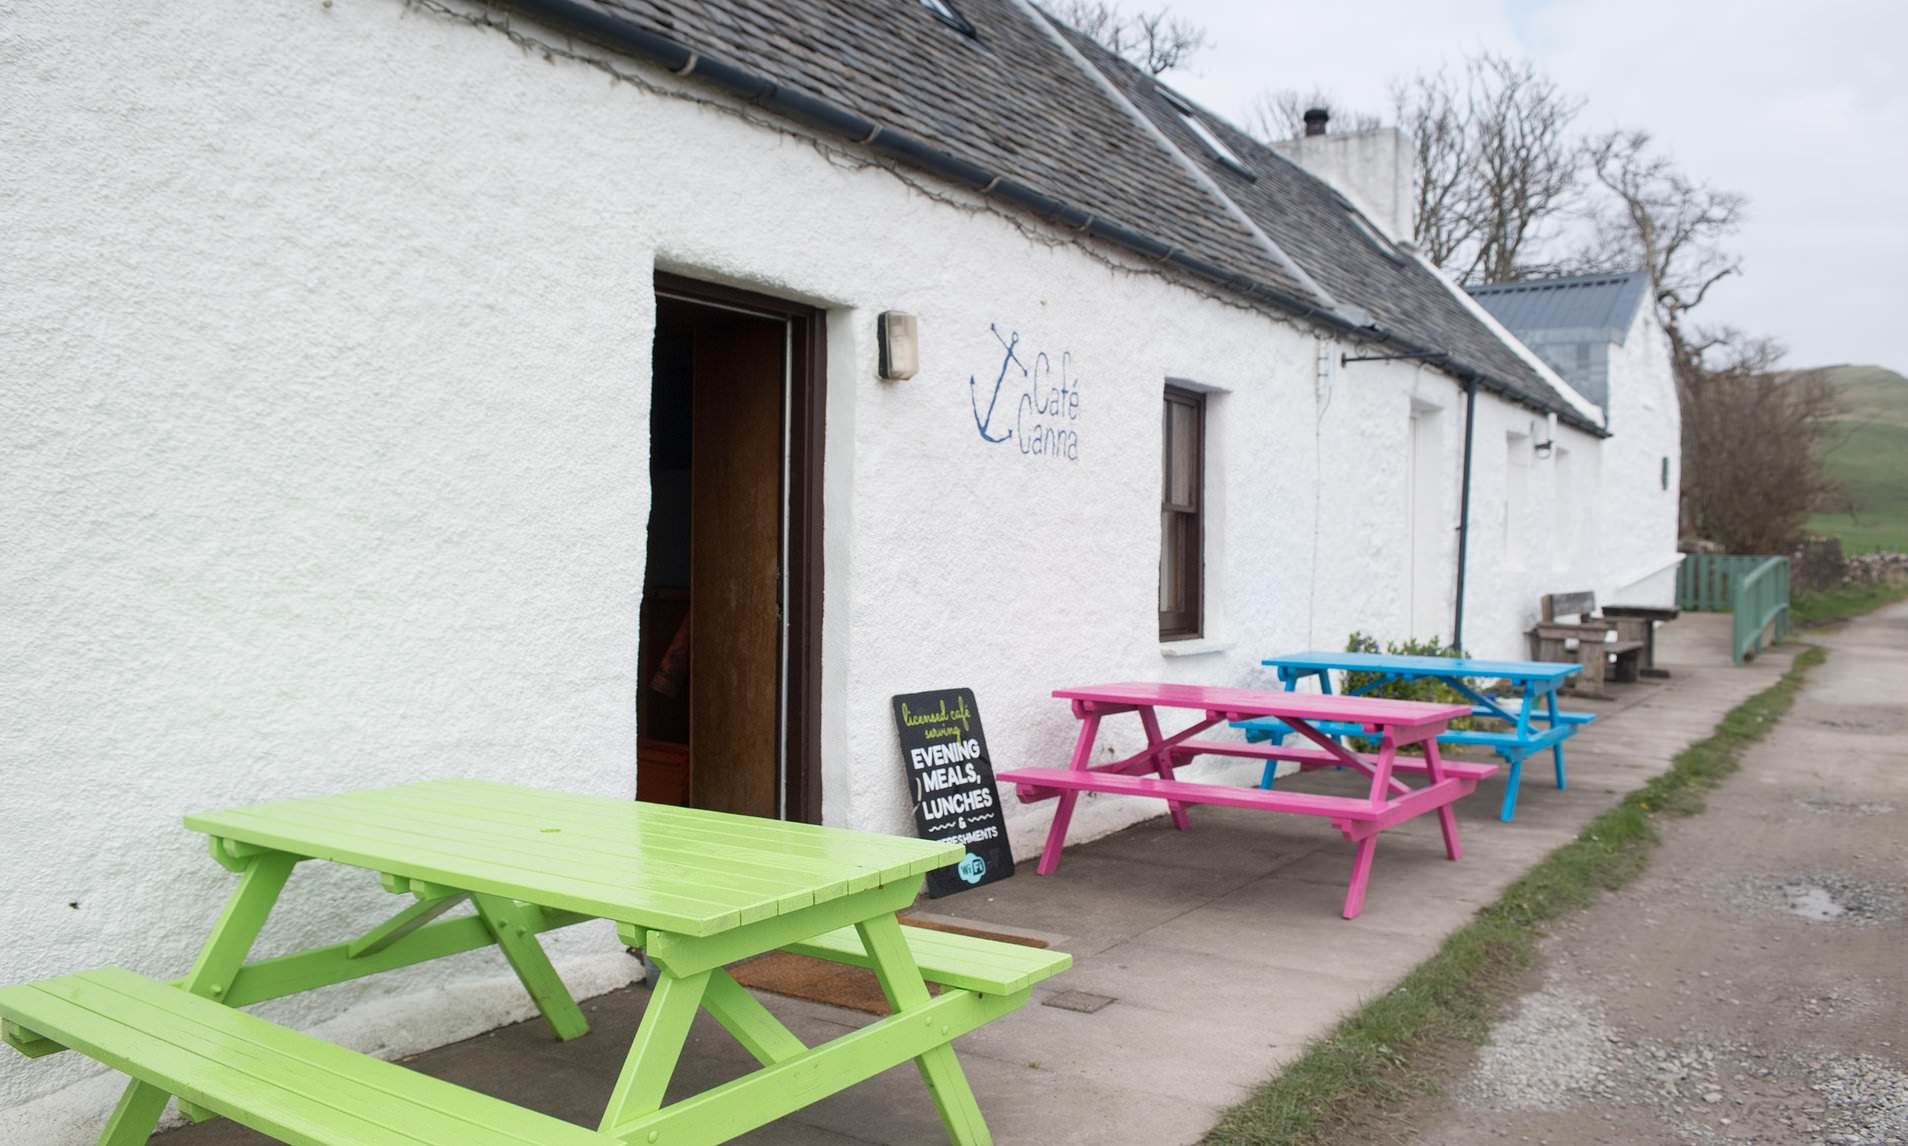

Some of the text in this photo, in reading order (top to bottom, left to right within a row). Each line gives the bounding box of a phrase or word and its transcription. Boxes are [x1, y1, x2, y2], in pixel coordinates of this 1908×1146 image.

[1033, 351, 1079, 420] Café
[1017, 393, 1079, 460] Canna
[901, 699, 949, 726] licensed
[924, 723, 961, 743] serving
[910, 738, 980, 769] EVENING
[922, 763, 981, 792] MEALS,
[922, 788, 993, 820] LUNCHES
[958, 817, 967, 829] &
